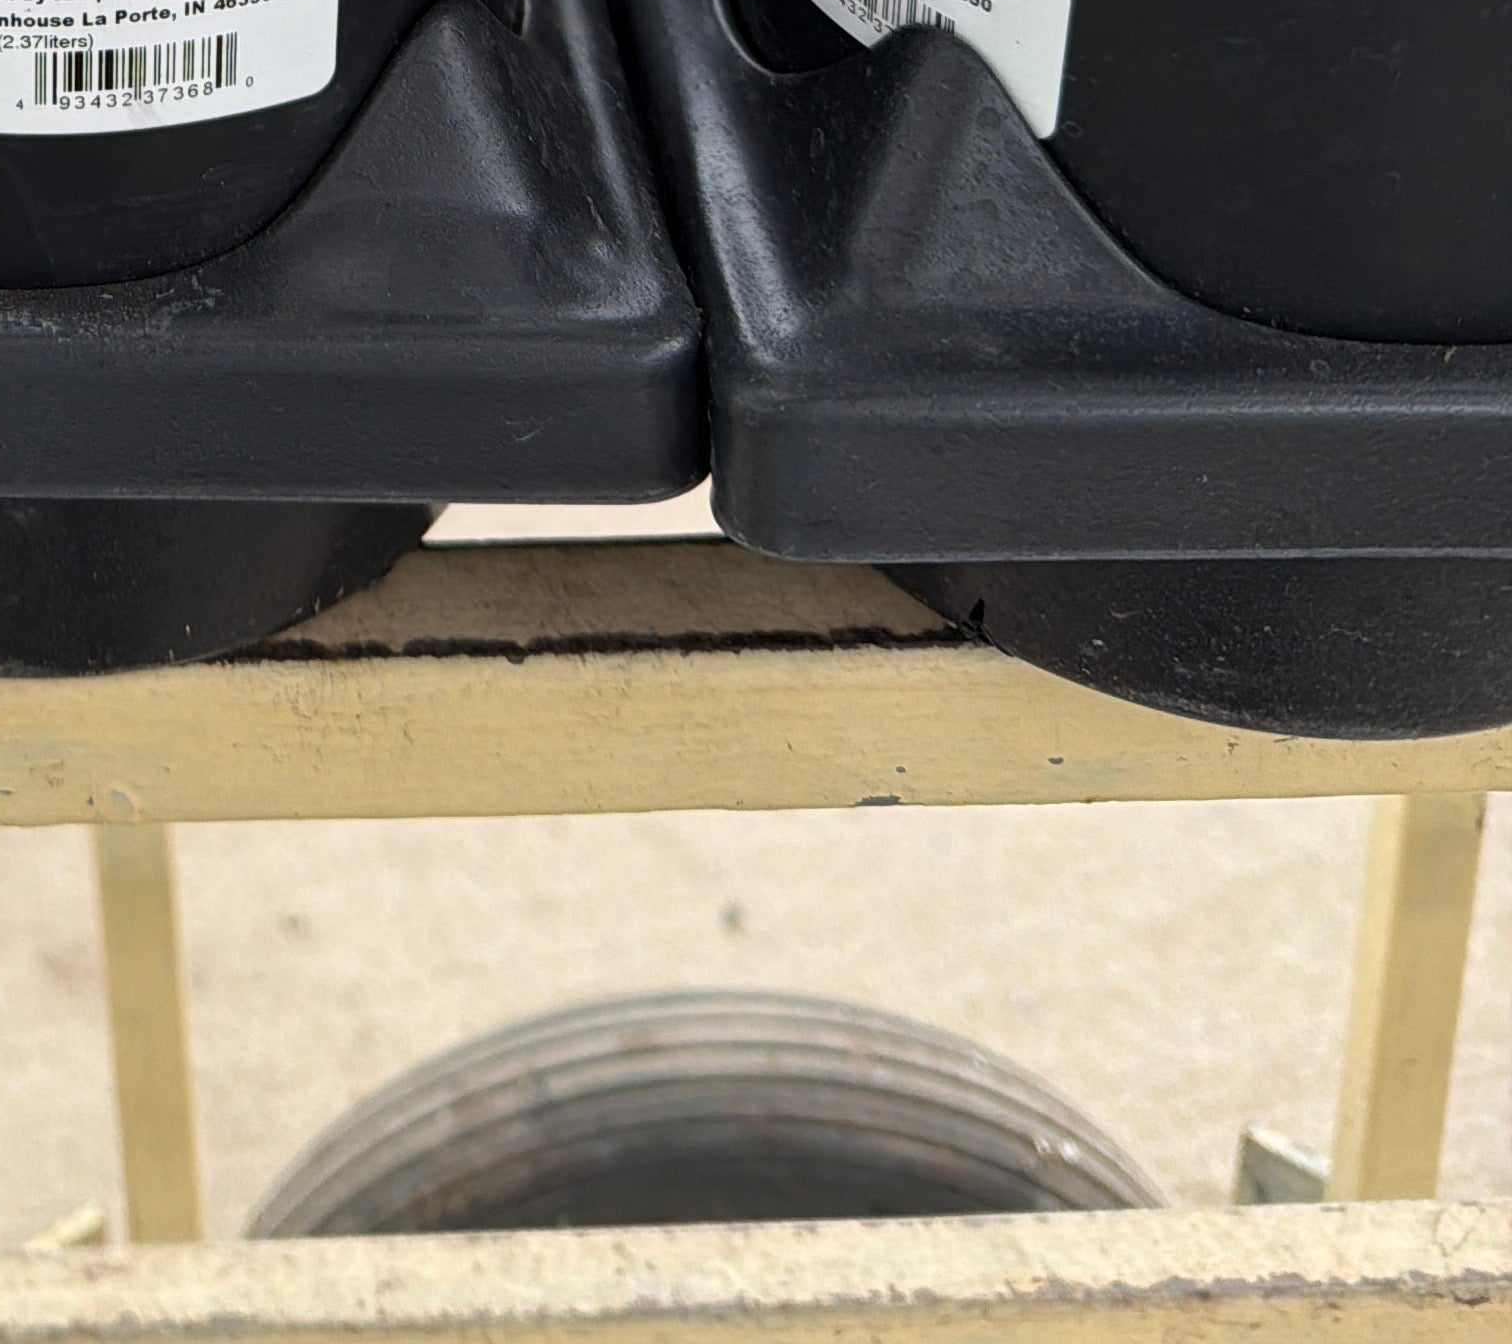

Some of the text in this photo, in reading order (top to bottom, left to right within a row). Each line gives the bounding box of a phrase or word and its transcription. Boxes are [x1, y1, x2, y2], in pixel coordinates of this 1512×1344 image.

[82, 12, 107, 26] La
[115, 7, 177, 24] Porte,
[184, 0, 206, 16] IN
[16, 75, 254, 110] 4 93432 37368 0
